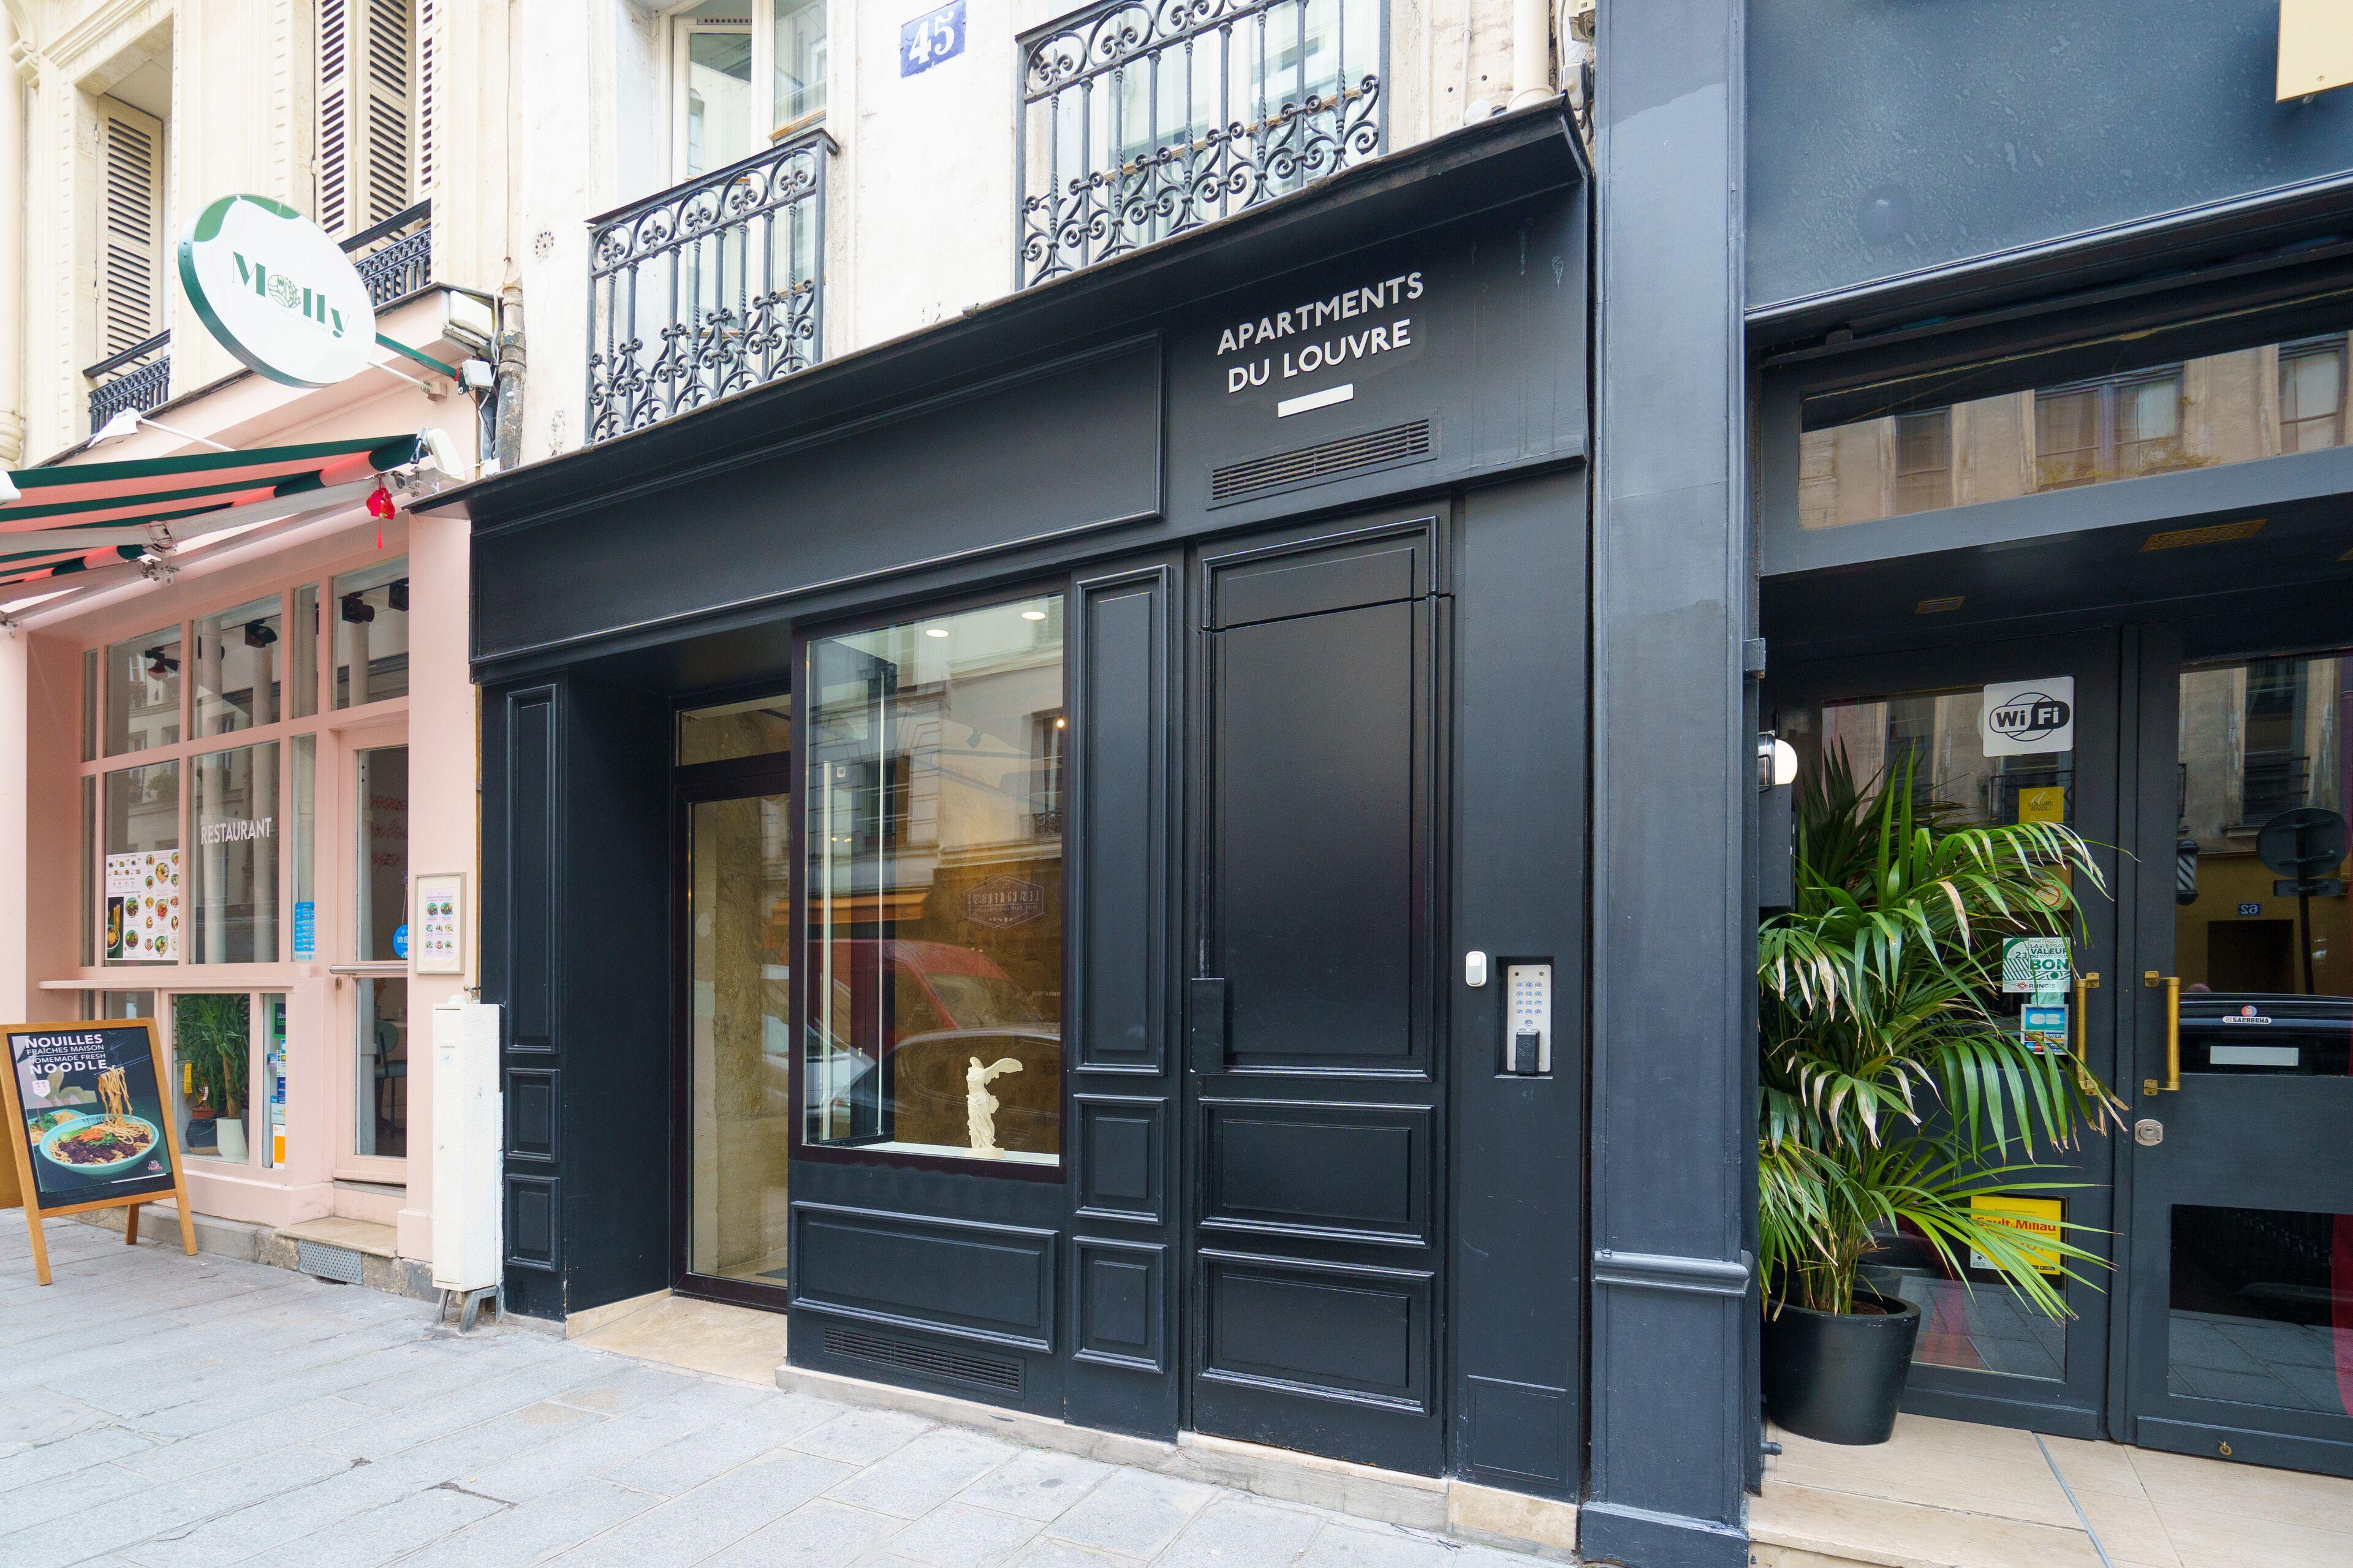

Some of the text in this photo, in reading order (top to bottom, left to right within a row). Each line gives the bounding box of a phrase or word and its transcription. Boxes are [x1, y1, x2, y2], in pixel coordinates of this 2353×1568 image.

[909, 10, 955, 64] 45
[232, 251, 350, 338] Molly
[1217, 272, 1423, 355] APARTMENTS
[1229, 319, 1411, 393] DU LOUVRE
[201, 817, 271, 844] RESTAURANT
[2030, 959, 2069, 970] BON
[2029, 1013, 2061, 1025] CB
[25, 1034, 103, 1048] NOUILLES
[27, 1047, 68, 1055] FRAÎCHES
[28, 1055, 78, 1064] HOMEMADE
[29, 1059, 108, 1075] NOODLE
